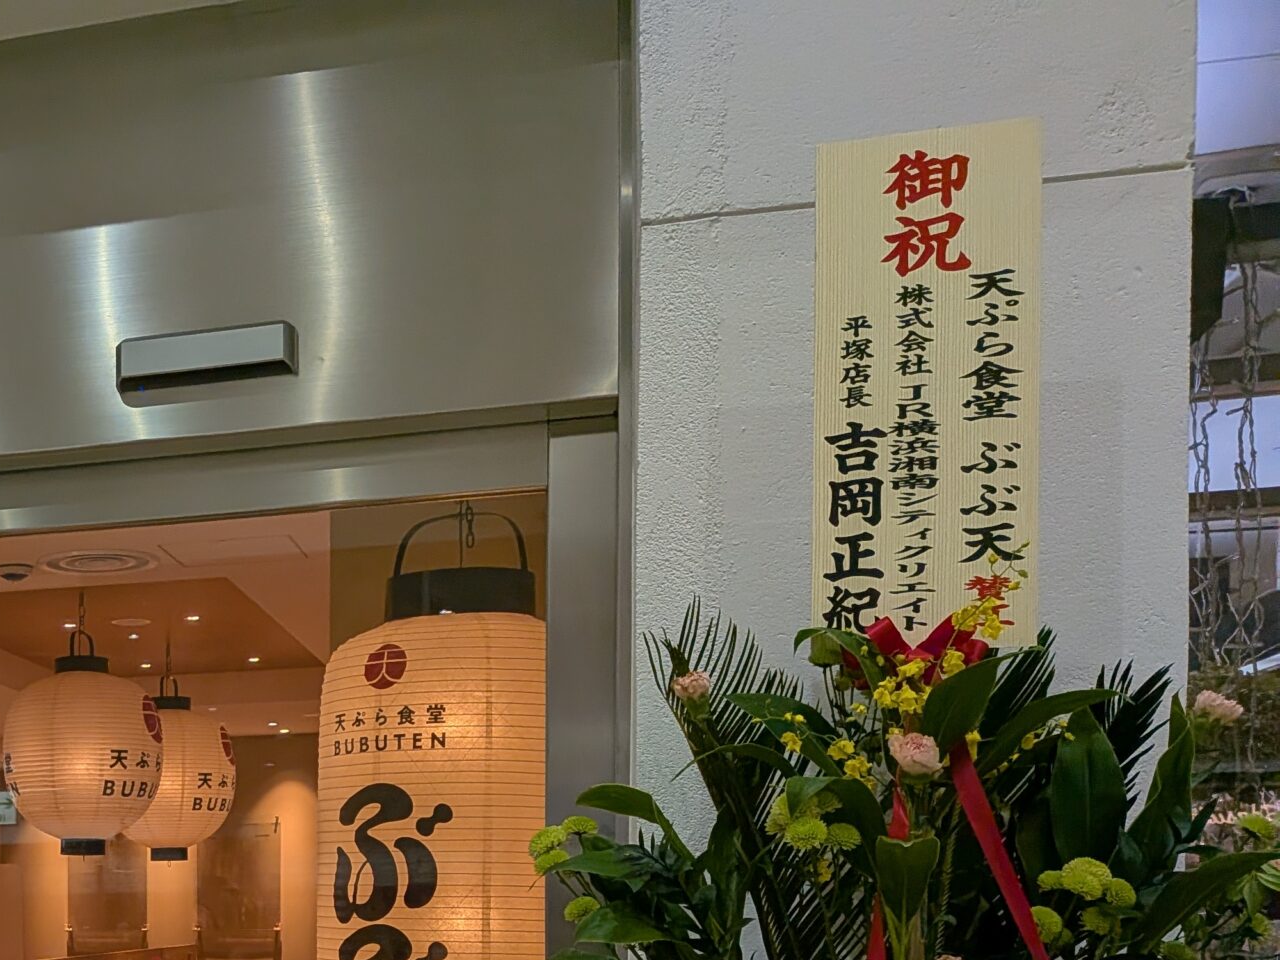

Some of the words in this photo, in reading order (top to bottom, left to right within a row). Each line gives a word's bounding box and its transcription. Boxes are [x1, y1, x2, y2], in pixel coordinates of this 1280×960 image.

[880, 150, 972, 277] 御祝
[839, 315, 875, 409] 平塚店長
[959, 268, 1025, 421] 天ぷら食堂
[823, 421, 888, 634] 吉岡正紀
[958, 442, 1025, 563] ぶぶ天
[334, 732, 446, 756] BUBUTEN
[335, 703, 446, 733] 天ぷら食堂
